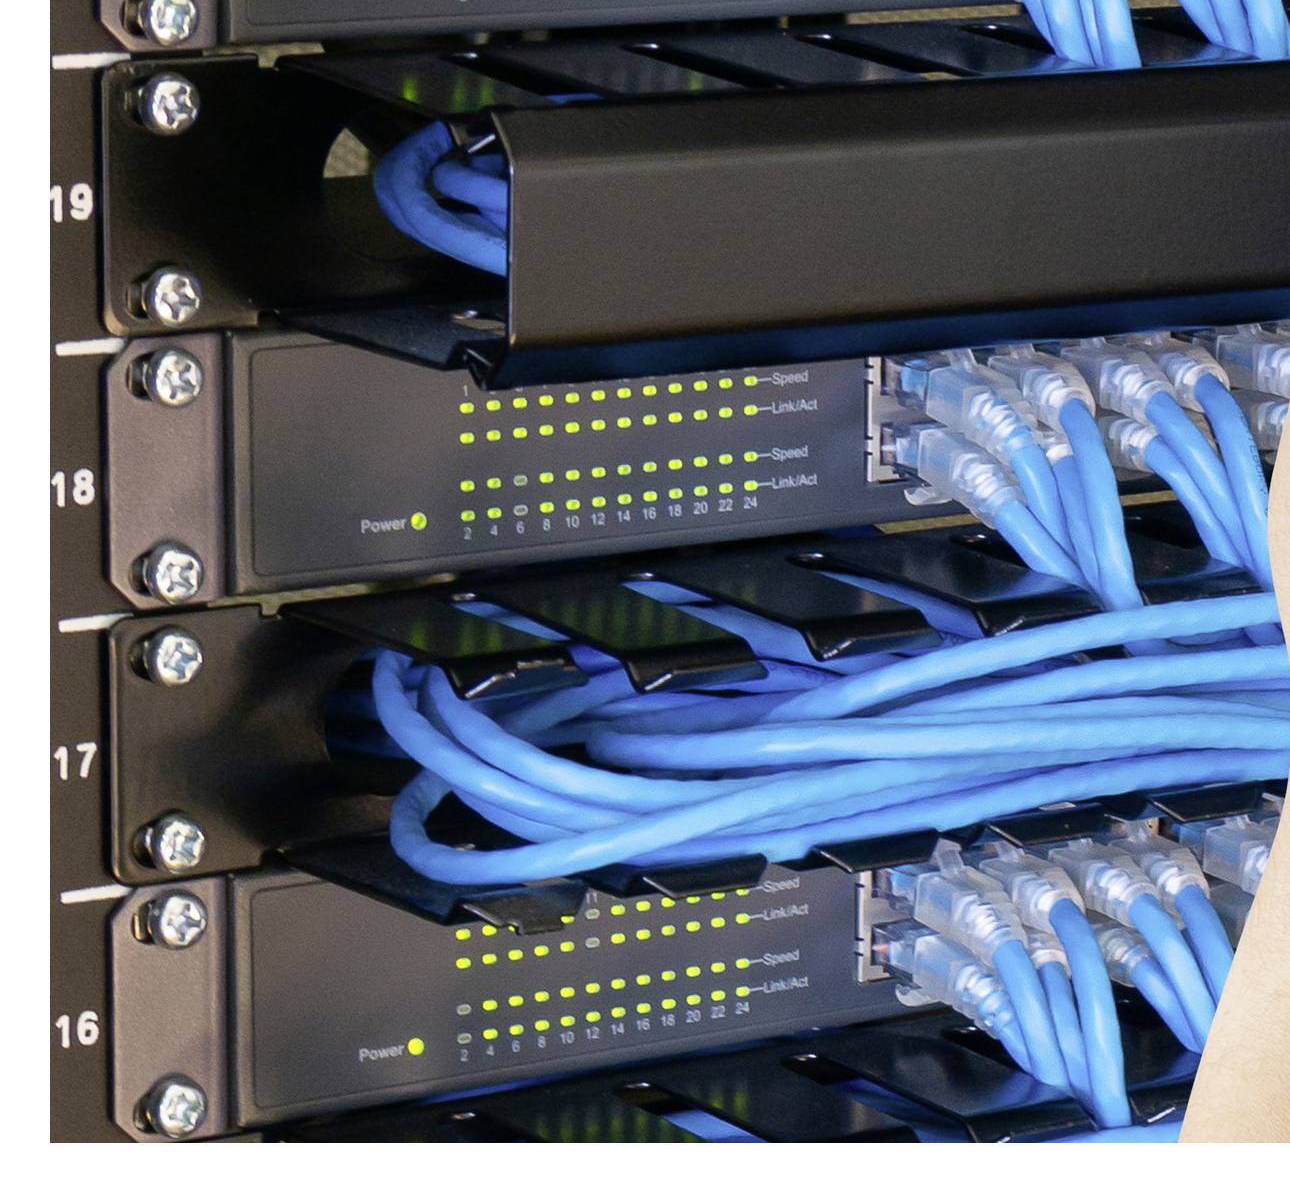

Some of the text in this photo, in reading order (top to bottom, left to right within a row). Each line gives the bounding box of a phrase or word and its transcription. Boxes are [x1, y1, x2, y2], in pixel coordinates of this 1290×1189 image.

[50, 182, 93, 223] 19
[772, 370, 809, 387] Speed
[771, 399, 818, 414] Link/Act
[771, 445, 809, 462] Speed
[51, 467, 95, 508] 18
[772, 474, 818, 489] Link/Act
[360, 517, 407, 534] Power
[464, 496, 758, 540] 2 4 6 8 10 12 14 16 18 20 22 24
[53, 741, 97, 781] 17
[762, 877, 799, 894] Speed
[763, 904, 809, 921] Link/Act
[762, 949, 800, 967] Speed
[764, 976, 809, 993] Link/Act
[55, 1010, 99, 1048] 16
[460, 1001, 750, 1062] 2 4 6 8 10 12 14 16 18 20 22 24
[359, 1044, 405, 1062] Power
